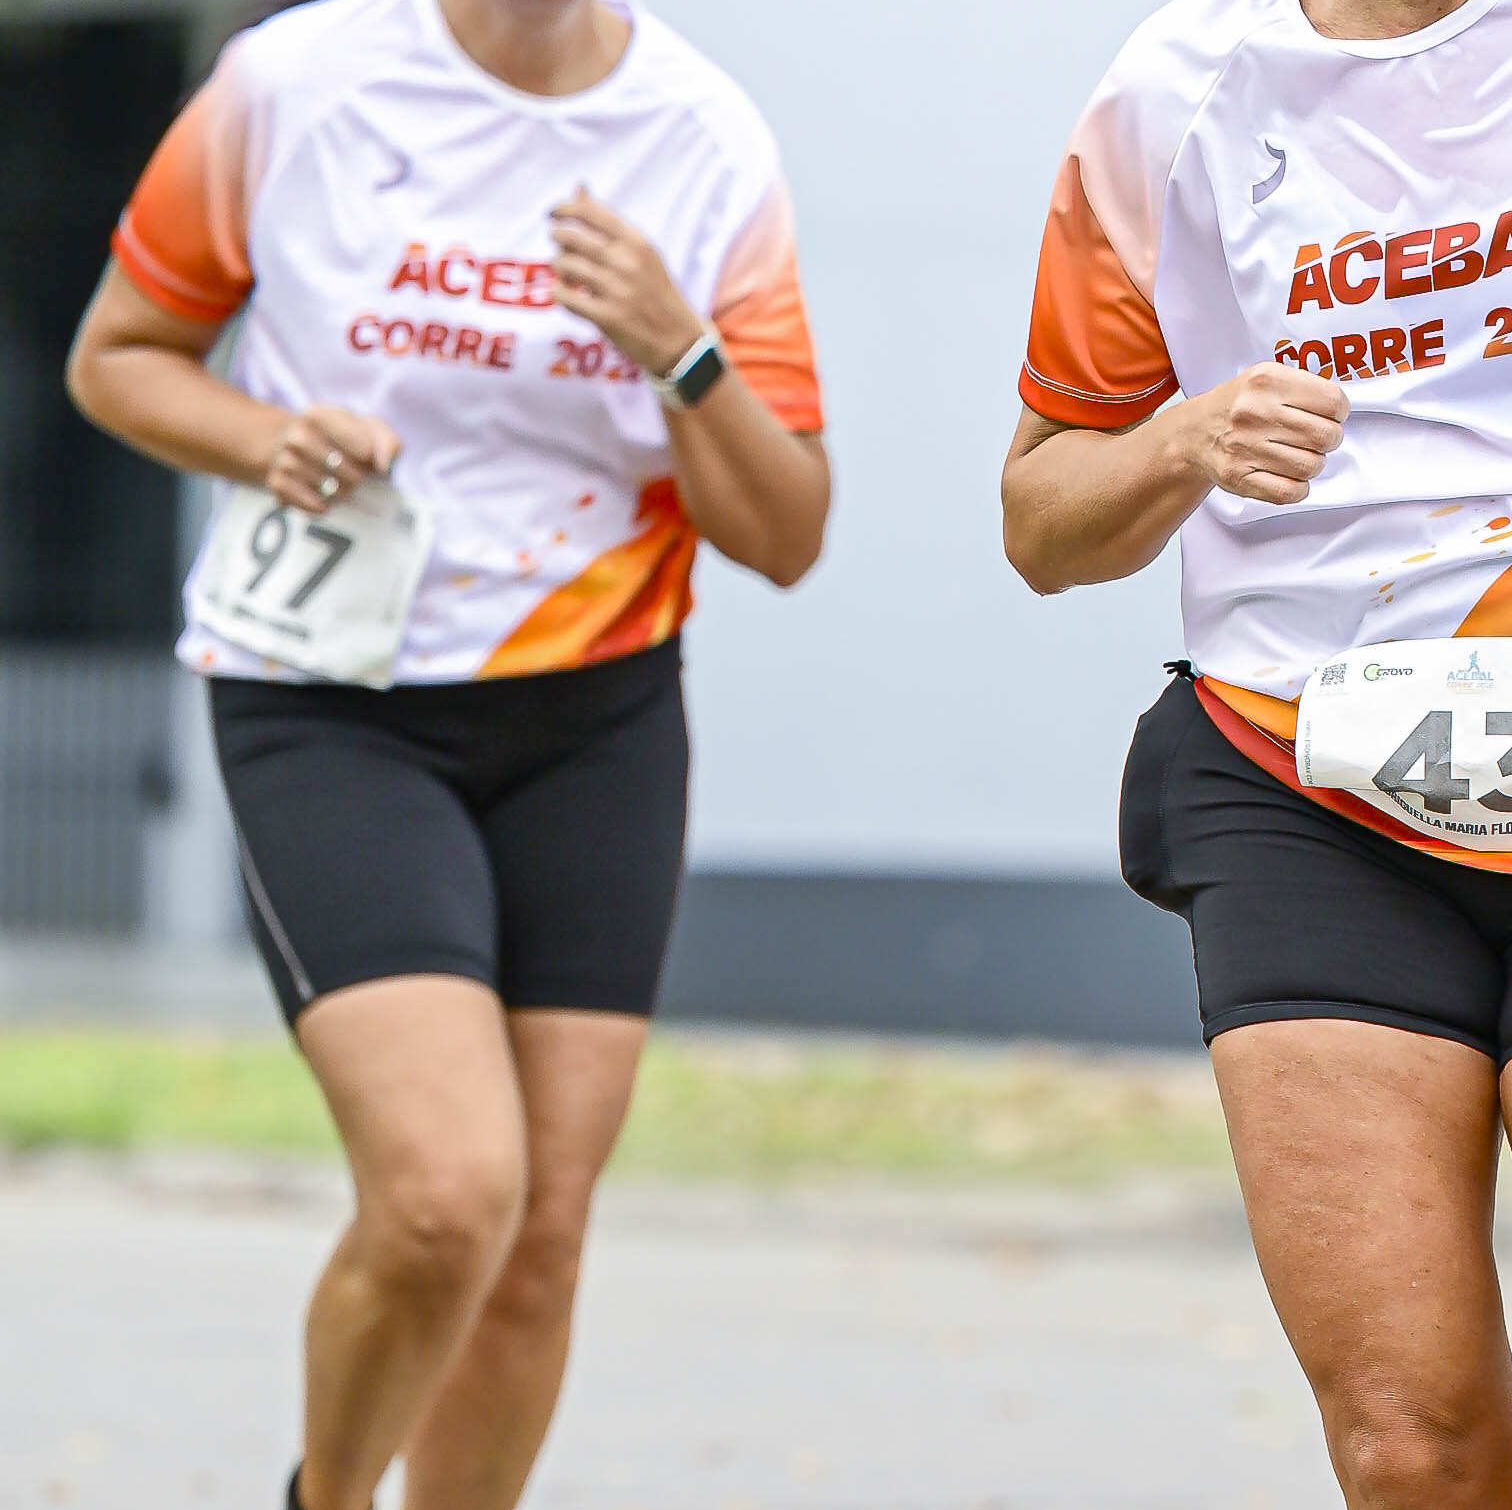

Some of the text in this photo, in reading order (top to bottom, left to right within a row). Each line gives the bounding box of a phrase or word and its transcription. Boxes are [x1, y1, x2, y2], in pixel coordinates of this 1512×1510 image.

[390, 243, 556, 308] ACEB
[347, 314, 515, 371] CORRE
[249, 506, 355, 610] 97
[1445, 822, 1488, 836] MARIA
